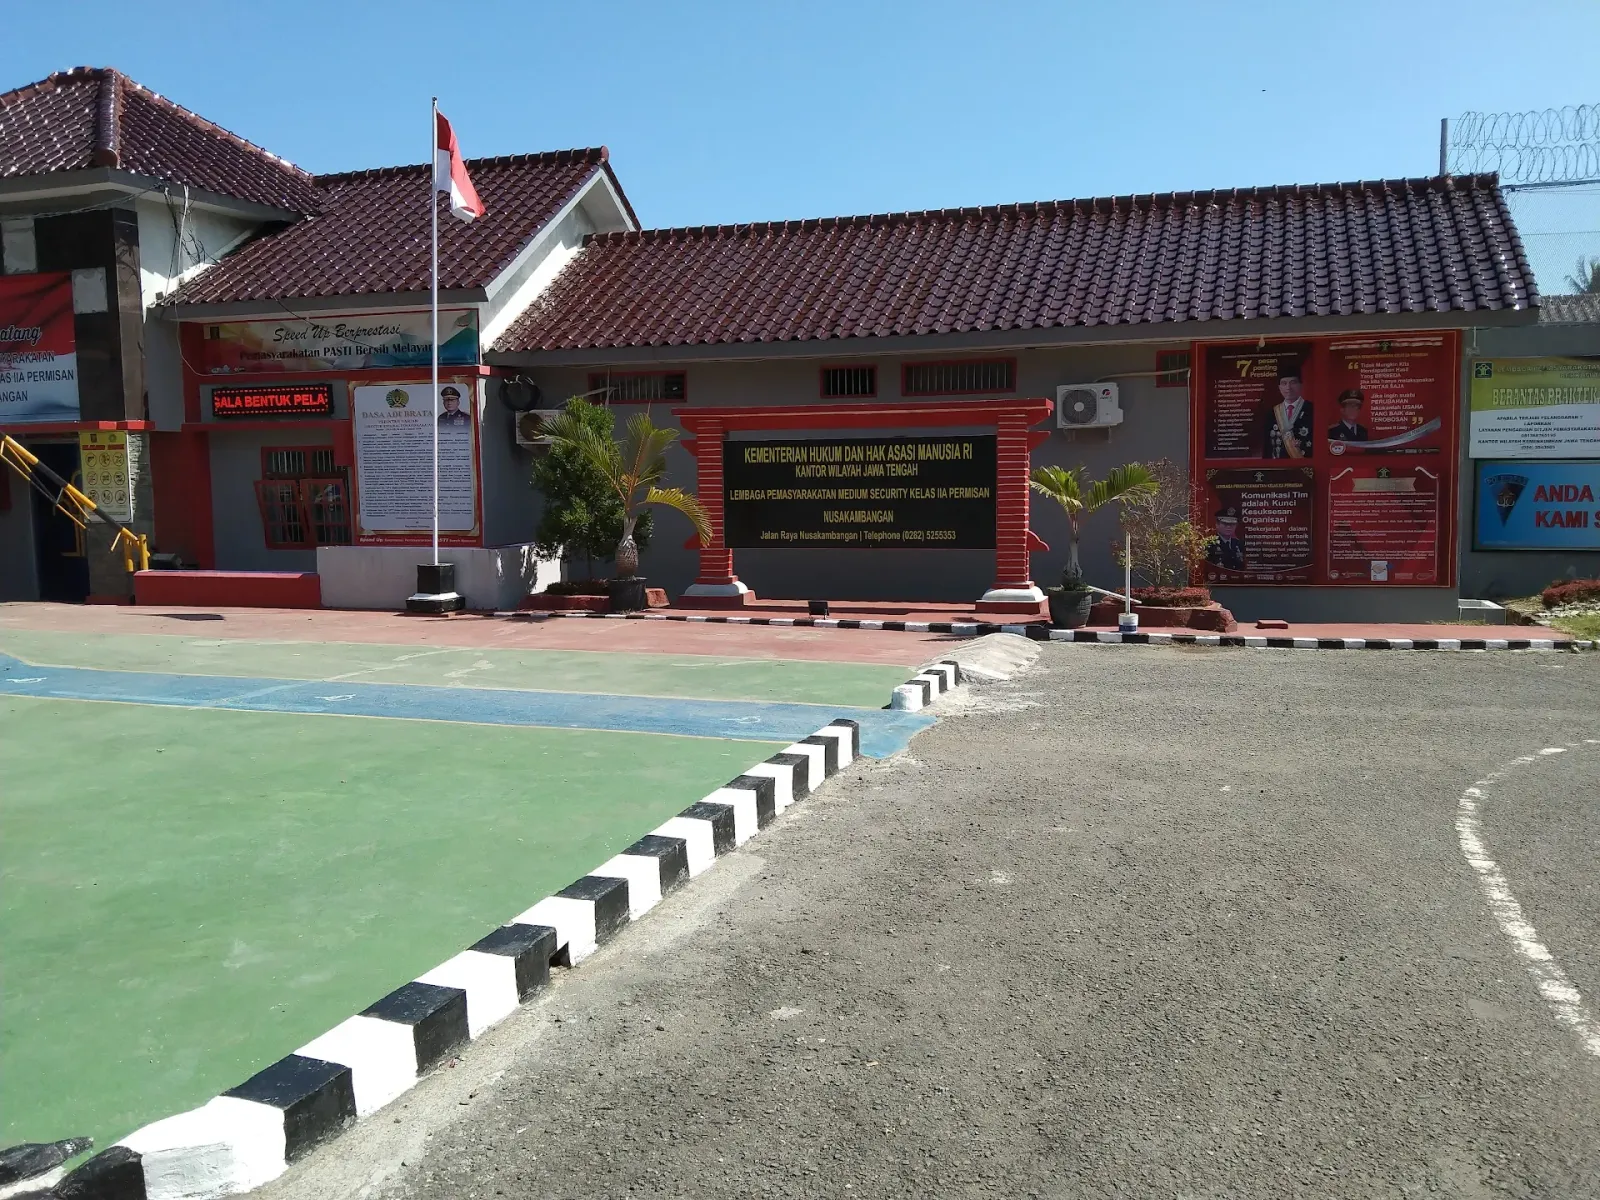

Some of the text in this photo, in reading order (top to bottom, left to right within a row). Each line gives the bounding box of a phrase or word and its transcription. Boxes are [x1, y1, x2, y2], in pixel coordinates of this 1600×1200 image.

[274, 322, 401, 343] Speed Up Berprestasi
[240, 347, 320, 362] Pemasyarakatan
[323, 345, 352, 358] PASTI
[356, 342, 388, 356] Bersih
[27, 369, 74, 382] PERMISAN
[1236, 360, 1252, 378] 7
[244, 394, 292, 408] BENTUK
[294, 393, 326, 406] PELA
[1493, 387, 1545, 406] BERANTAS
[362, 411, 385, 419] DASA
[404, 409, 434, 419] BRATA
[744, 443, 973, 464] KEMENTERIAN HUKUM DAN HAK ASASI MANUSIA RI
[795, 463, 919, 478] KANTOR WILAYAH JAWA TENGAH
[729, 487, 990, 501] LEMBAGA PEMASYARAKATAN MEDIUM SECURITY KELAS IIA PERMISAN
[1241, 491, 1309, 500] Komunikasi Tim
[1533, 485, 1594, 503] ANDA
[1241, 499, 1297, 508] adalah Kunci
[823, 510, 894, 524] NUSAKAMBANGAN
[1241, 508, 1293, 516] Kesuksesan
[1242, 515, 1287, 525] Organisasi
[1535, 511, 1589, 528] KAMI
[760, 530, 779, 541] Jalan
[780, 530, 798, 542] Raya
[799, 530, 859, 543] Nusakambangan
[864, 530, 902, 543] Telephone
[902, 530, 925, 543] (0282)
[926, 530, 957, 541] 5255353
